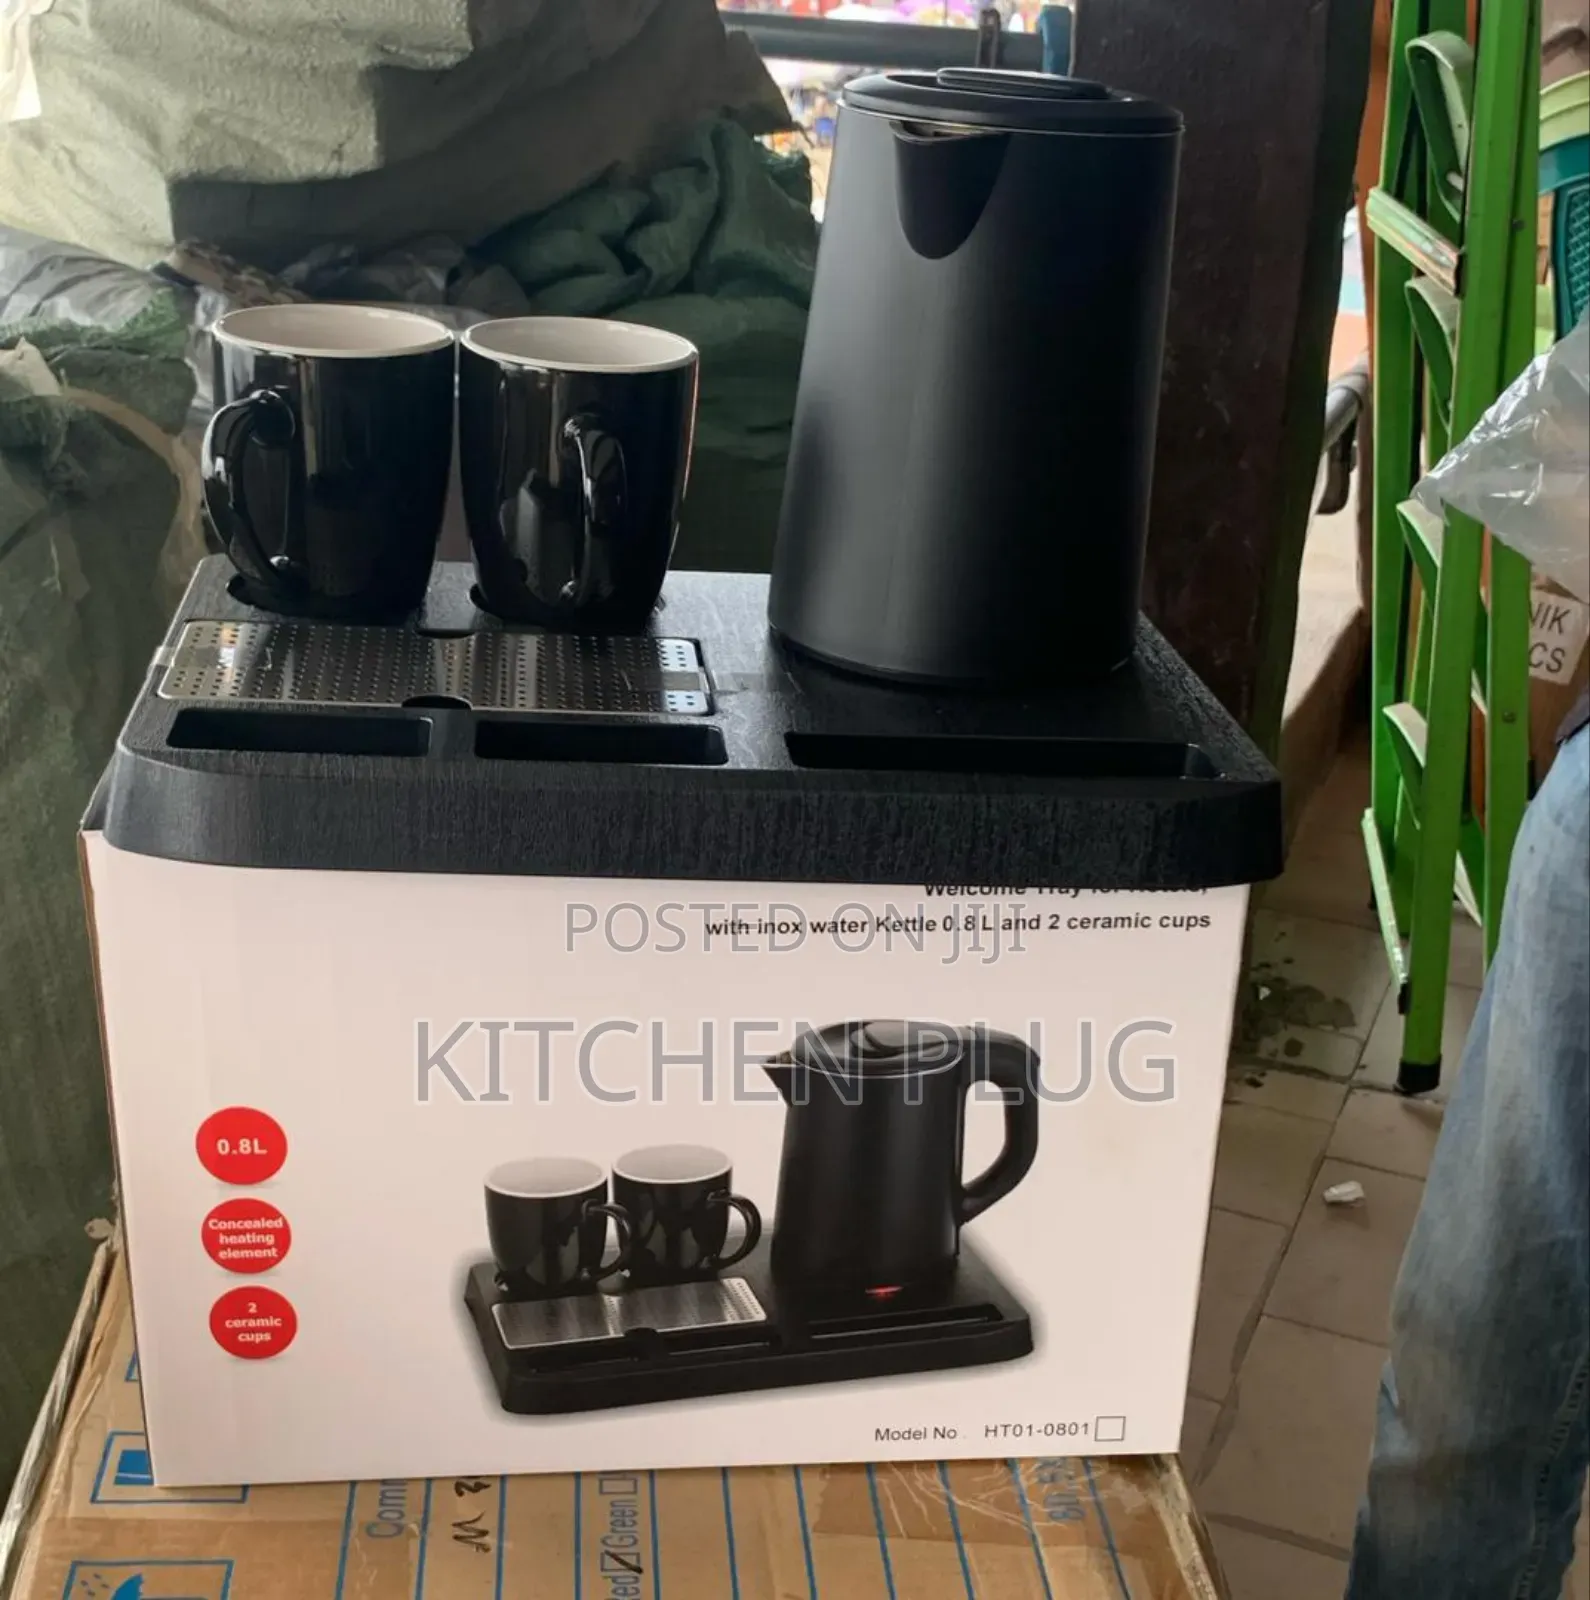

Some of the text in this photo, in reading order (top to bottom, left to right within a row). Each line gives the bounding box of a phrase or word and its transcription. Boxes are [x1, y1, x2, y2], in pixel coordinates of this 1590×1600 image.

[705, 917, 750, 936] with
[757, 916, 803, 935] inox
[809, 917, 869, 934] water
[874, 914, 938, 933] Kettle
[1000, 914, 1042, 931] and
[1047, 913, 1061, 931] 2
[1066, 911, 1152, 931] ceramic
[1158, 912, 1212, 932] cups
[216, 1138, 268, 1155] 0.8L
[208, 1217, 284, 1230] Concealed
[218, 1232, 275, 1246] heating
[218, 1247, 278, 1260] element
[247, 1302, 258, 1314] 2
[224, 1315, 283, 1329] ceramic
[237, 1330, 272, 1343] cups
[874, 1427, 928, 1442] Model
[984, 1421, 1090, 1439] HT01-0801
[600, 1499, 639, 1548] Green
[601, 1575, 641, 1600] ed
